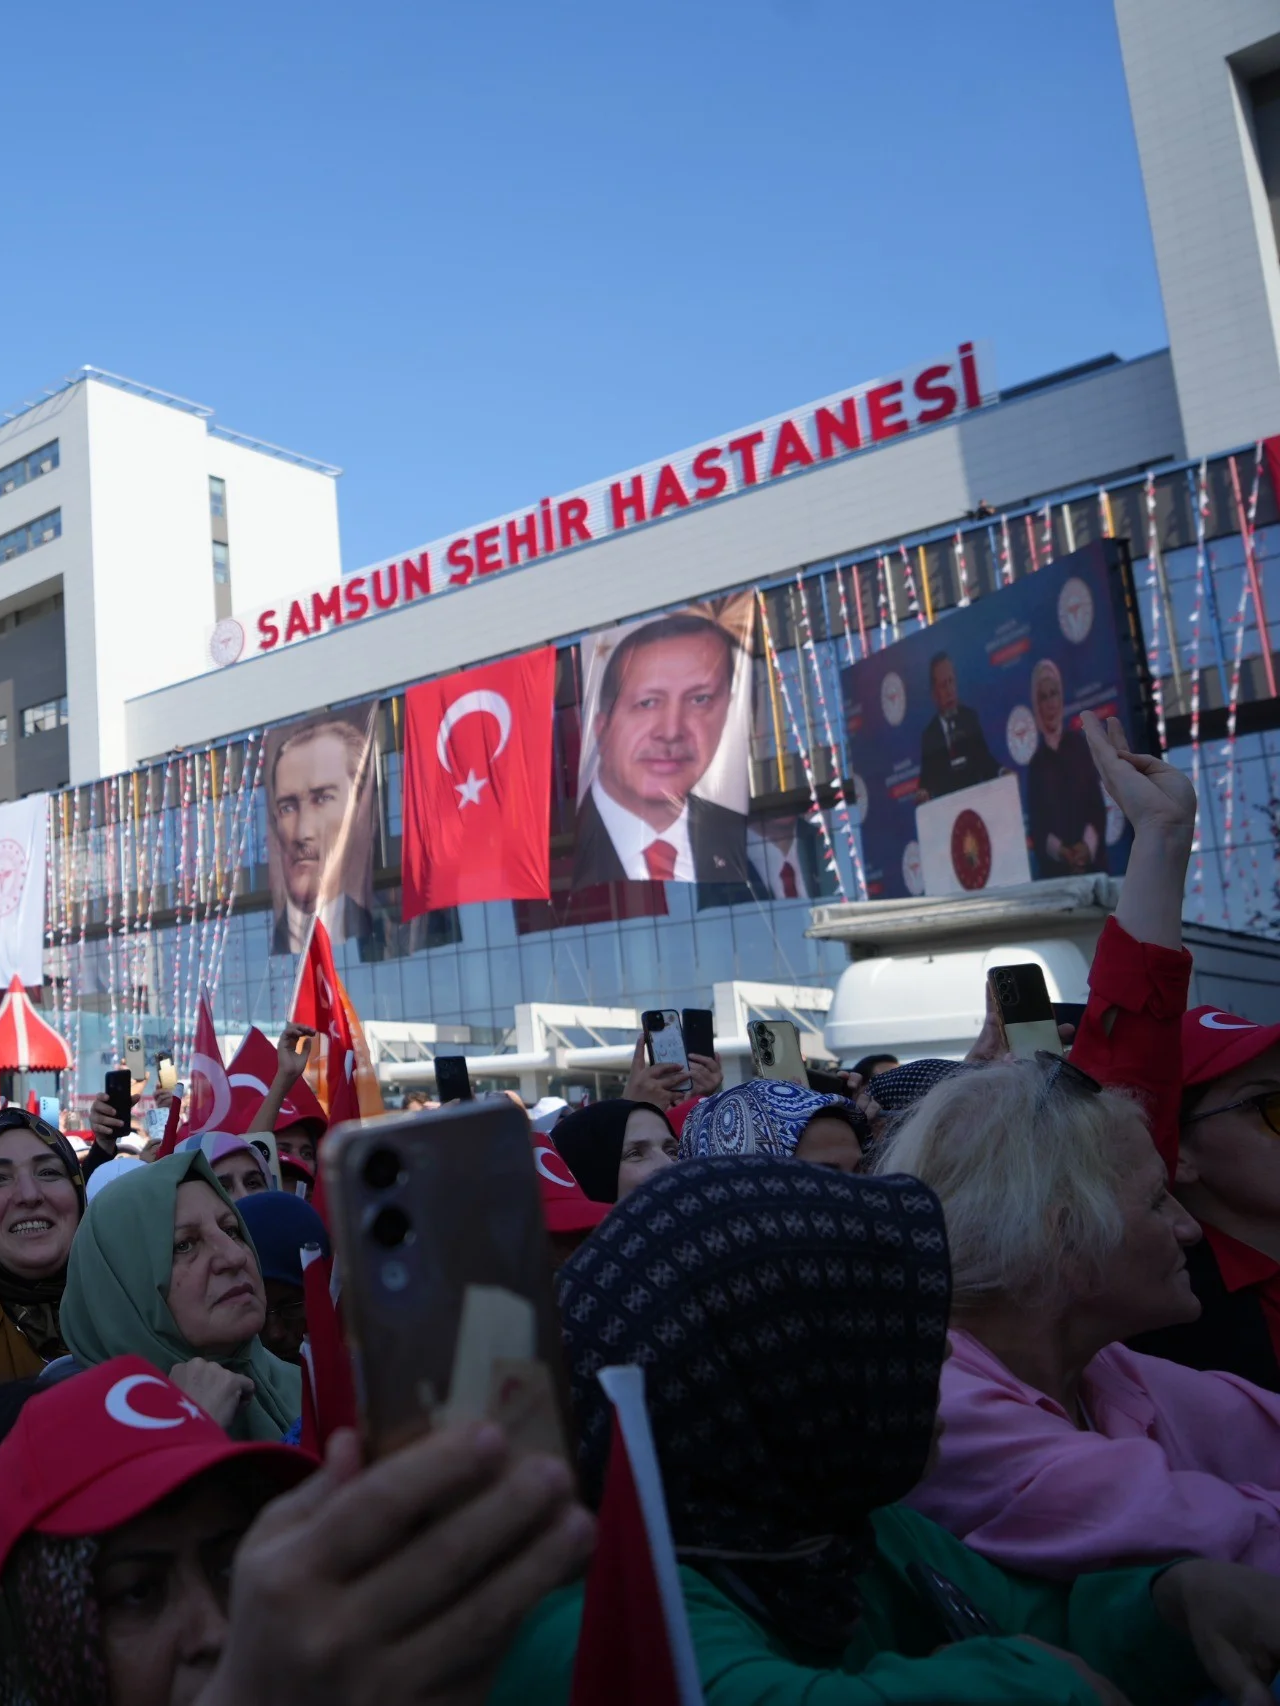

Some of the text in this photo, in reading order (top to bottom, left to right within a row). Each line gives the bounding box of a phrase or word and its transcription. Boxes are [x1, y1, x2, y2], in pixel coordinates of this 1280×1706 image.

[257, 341, 982, 650] SAMSUN ŞEHİR HASTANESİ
